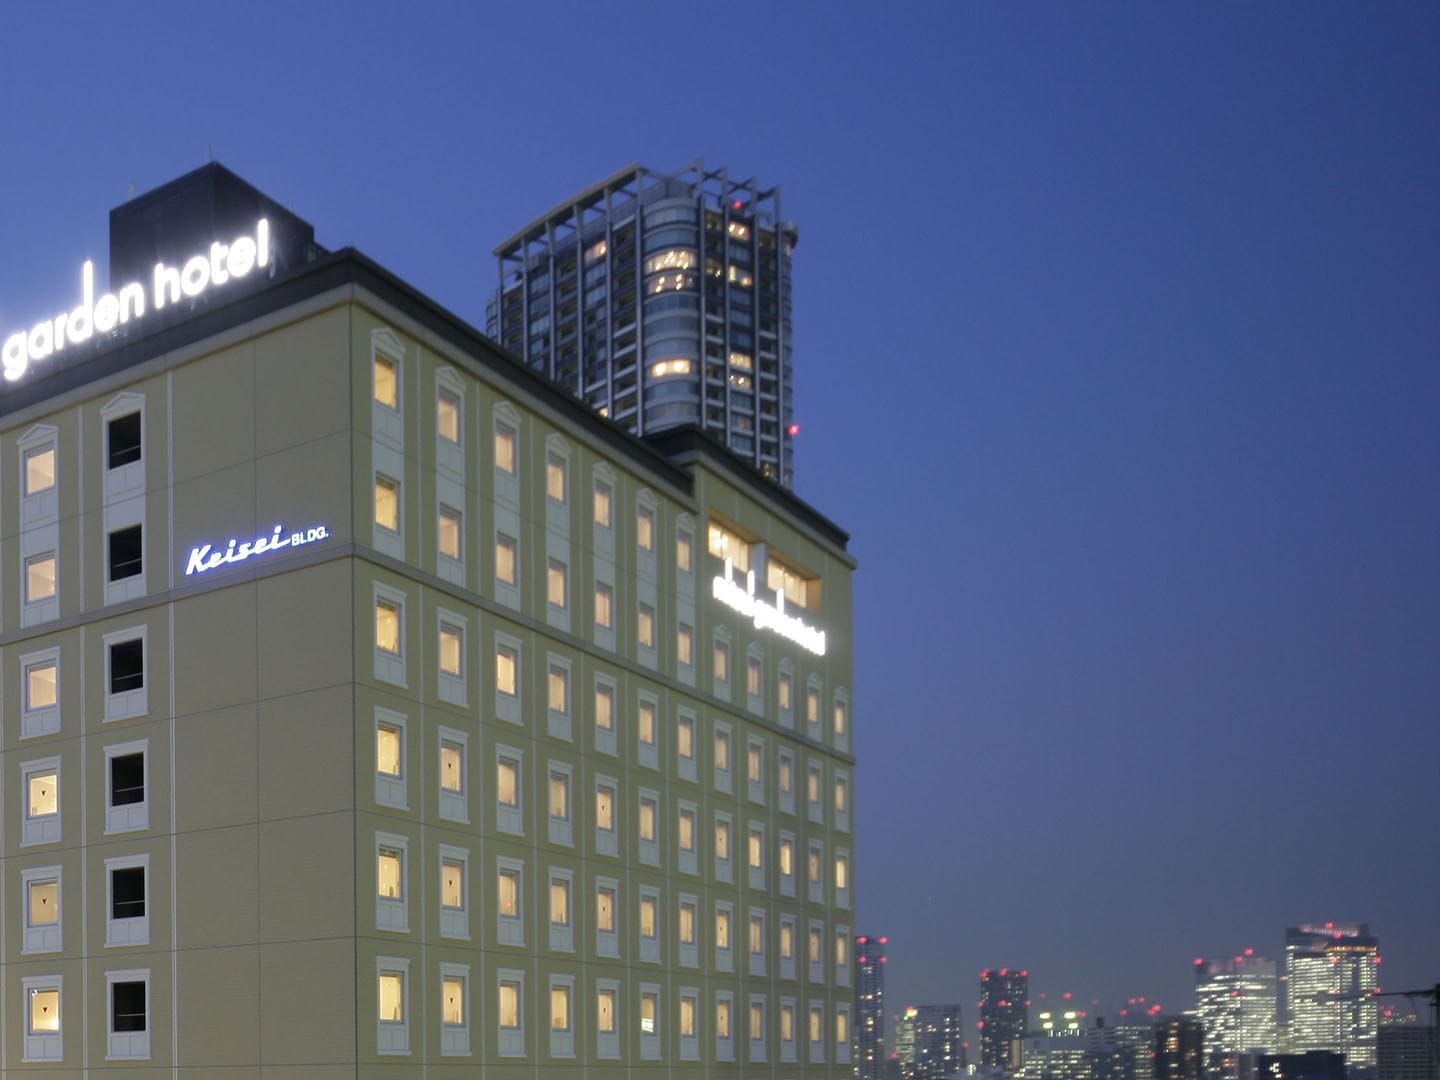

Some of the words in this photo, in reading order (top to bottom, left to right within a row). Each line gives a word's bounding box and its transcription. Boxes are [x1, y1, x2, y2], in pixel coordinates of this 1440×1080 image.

[2, 260, 144, 381] garden
[154, 218, 269, 308] hotel
[185, 525, 291, 575] Keisei
[291, 526, 329, 547] BLDG.
